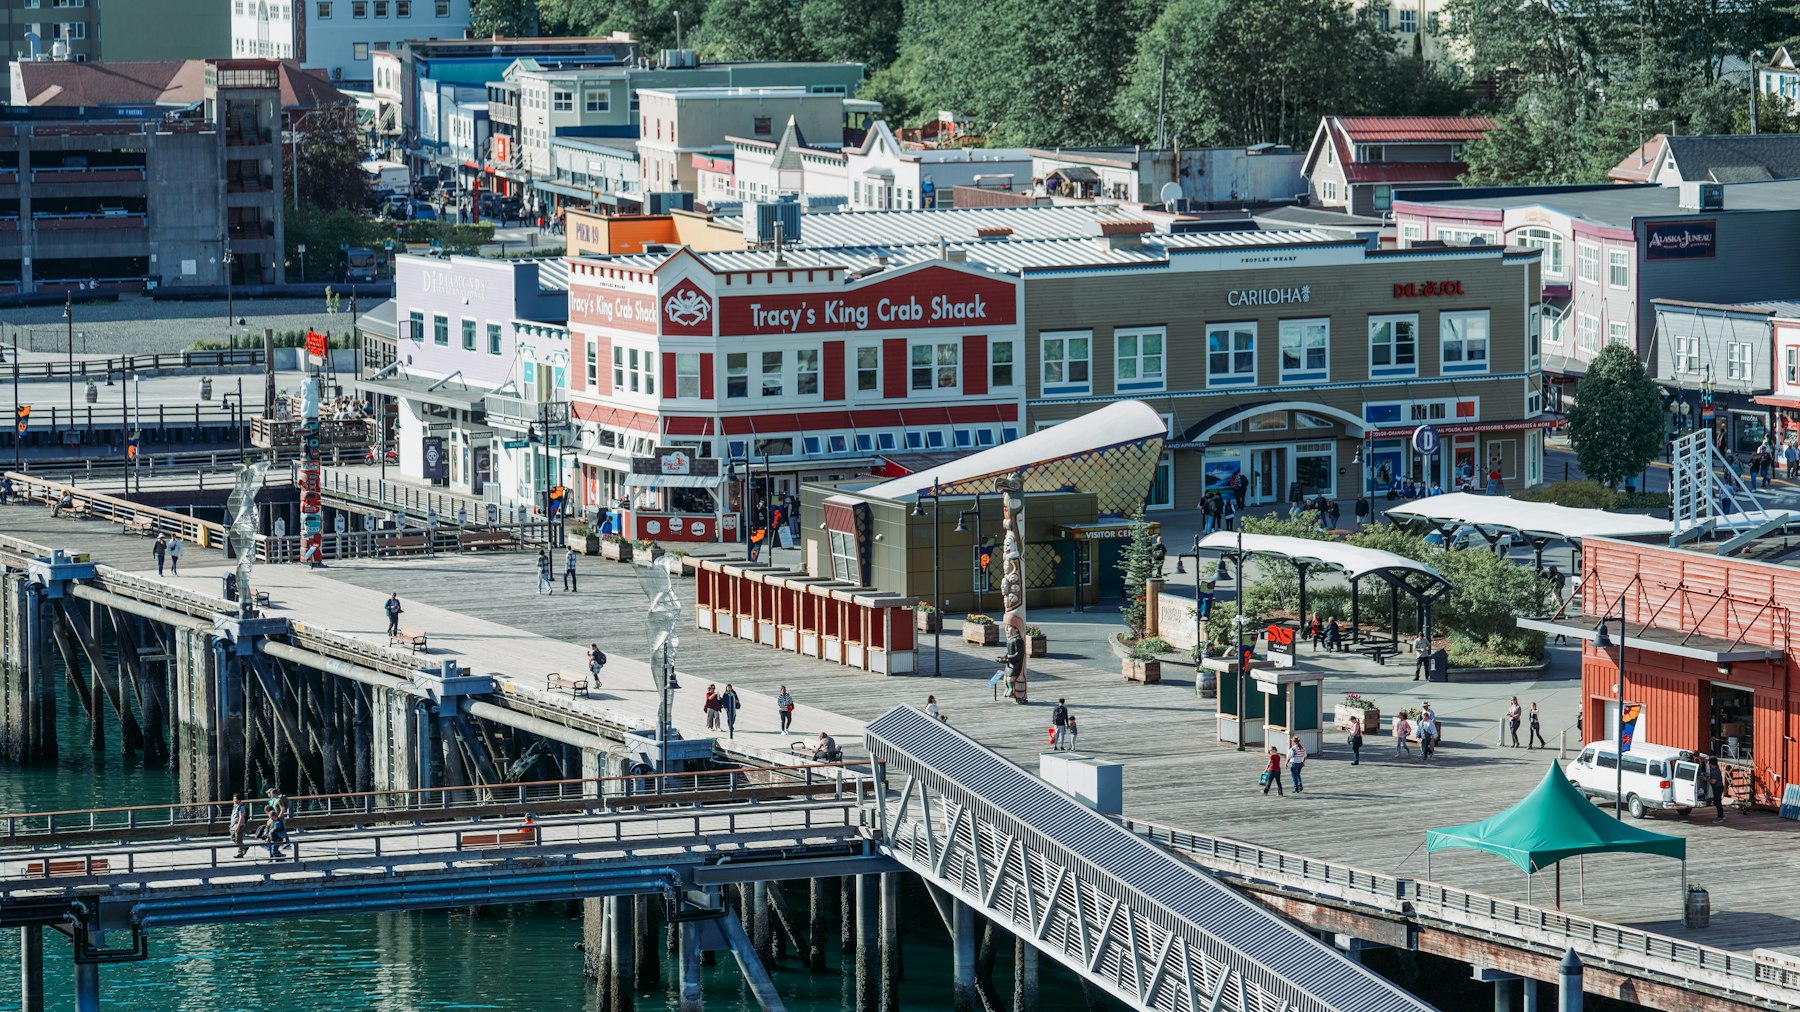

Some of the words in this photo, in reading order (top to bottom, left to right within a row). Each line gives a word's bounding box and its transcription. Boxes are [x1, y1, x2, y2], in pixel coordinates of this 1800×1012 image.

[576, 222, 590, 241] PIER
[1228, 287, 1302, 306] CARILOHA
[1394, 283, 1417, 298] DEL
[1440, 280, 1465, 296] SOL
[570, 291, 594, 318] Tracy's
[596, 295, 613, 322] King
[615, 297, 633, 319] Crab
[635, 300, 656, 323] Shack
[750, 302, 816, 331] Tracy's
[824, 300, 868, 329] King
[877, 295, 923, 321] Crab
[931, 294, 987, 320] Shack
[1423, 431, 1433, 450] D
[1086, 530, 1115, 539] VISITOR
